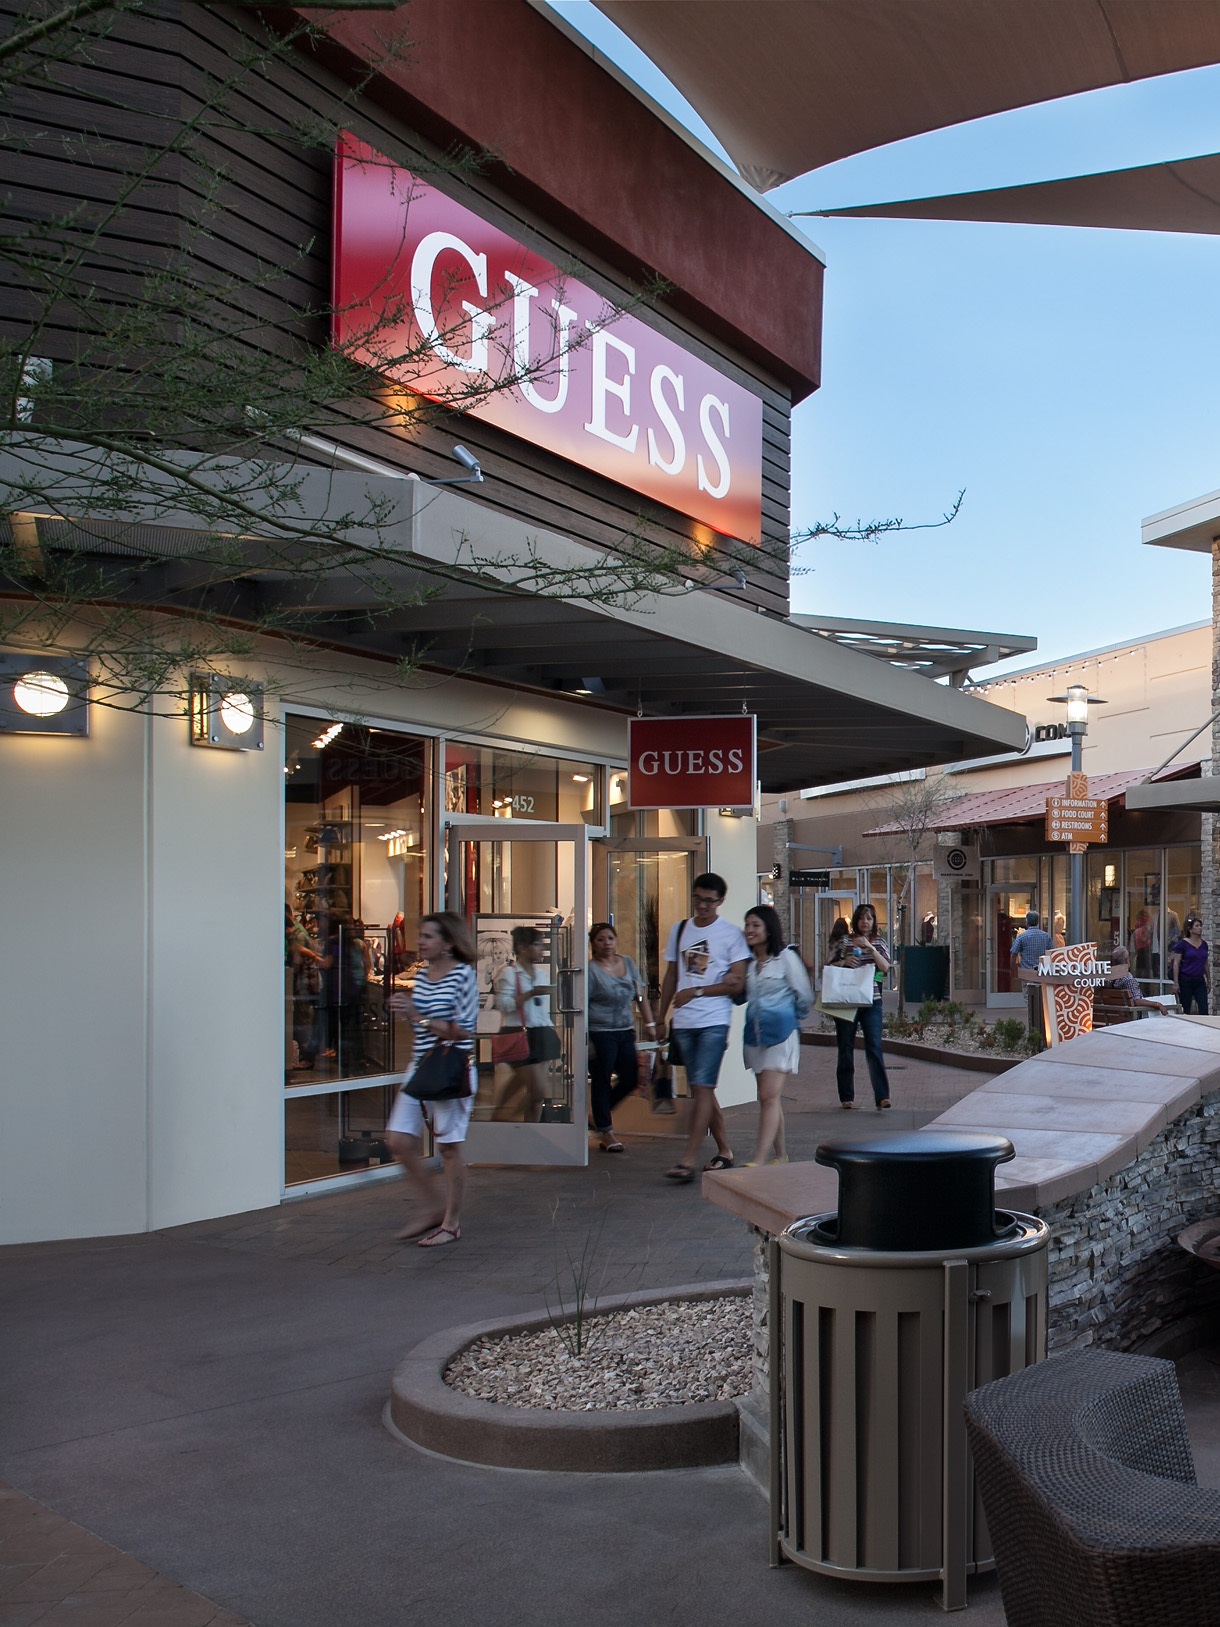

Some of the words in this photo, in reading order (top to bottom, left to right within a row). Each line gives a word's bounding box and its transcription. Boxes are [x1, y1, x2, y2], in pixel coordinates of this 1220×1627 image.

[410, 231, 732, 499] GUESS
[638, 748, 744, 776] GUESS
[512, 795, 535, 813] 452
[1061, 799, 1097, 808] INFORMATION
[1061, 810, 1077, 818] FOOD
[1077, 811, 1095, 819] COURT
[1061, 821, 1093, 830] RESTROOMS
[1061, 832, 1073, 840] ATM
[1038, 960, 1112, 977] MESQUITE
[1074, 977, 1106, 988] COURT
